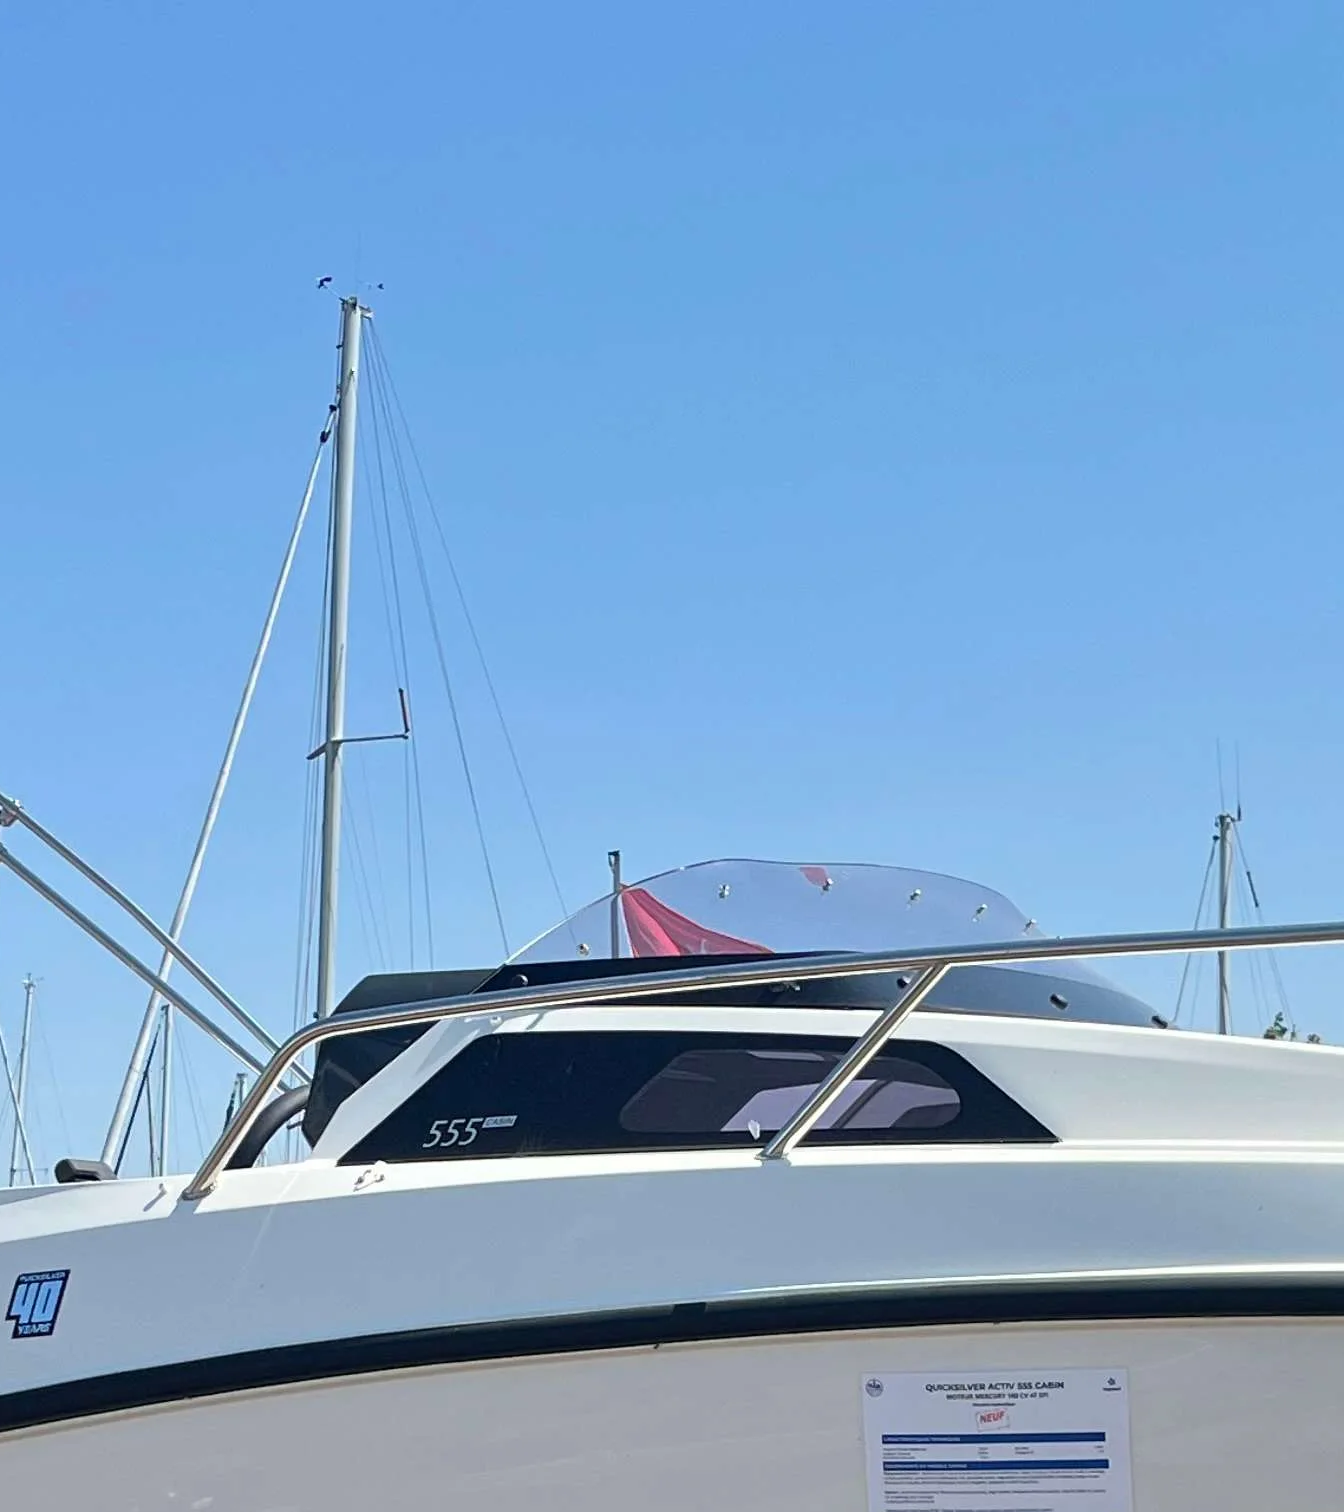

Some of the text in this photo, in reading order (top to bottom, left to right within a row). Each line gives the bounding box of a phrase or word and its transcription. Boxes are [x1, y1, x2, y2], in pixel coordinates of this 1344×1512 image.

[422, 1118, 484, 1148] 555
[9, 1279, 63, 1324] 40
[925, 1382, 986, 1393] QUICKSILVER
[988, 1382, 1016, 1391] ACTIV
[1035, 1381, 1065, 1390] CABIN
[979, 1410, 1005, 1424] NEUF
